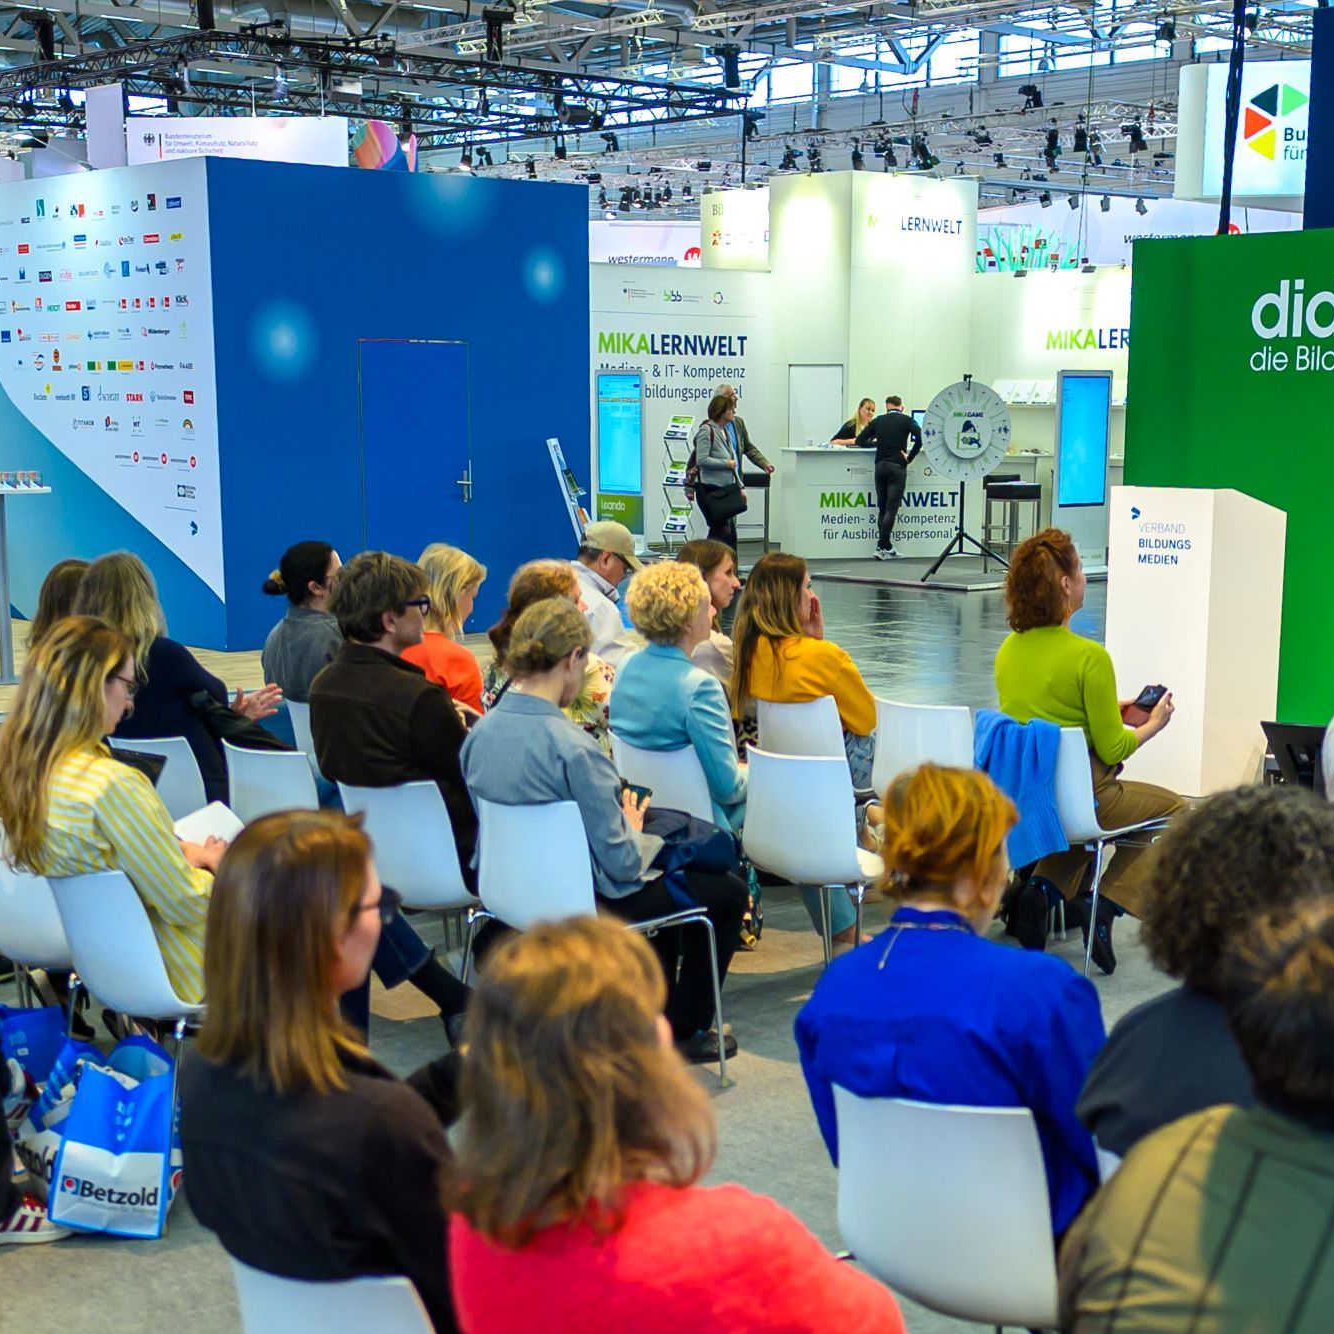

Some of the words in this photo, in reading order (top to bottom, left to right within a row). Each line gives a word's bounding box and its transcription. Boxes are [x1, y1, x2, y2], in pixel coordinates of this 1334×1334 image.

[1284, 127, 1306, 142] Bu
[608, 255, 675, 265] westermann
[598, 332, 748, 356] MIKALERNWELT
[1249, 346, 1289, 371] die
[652, 364, 661, 377] &
[665, 364, 679, 377] IT-
[683, 365, 746, 381] Kompetenz
[126, 393, 143, 402] STARK
[819, 492, 959, 508] MIKALNWELT
[821, 513, 866, 525] Medien-
[868, 513, 877, 525] &
[897, 513, 957, 528] Kompetenz
[1139, 522, 1186, 534] VERBAND
[823, 528, 839, 540] für
[841, 528, 954, 542] Ausbilngspersonal
[1138, 538, 1192, 550] BILDUNGS
[1138, 554, 1178, 565] MEDIEN
[79, 1180, 159, 1206] Betzold
